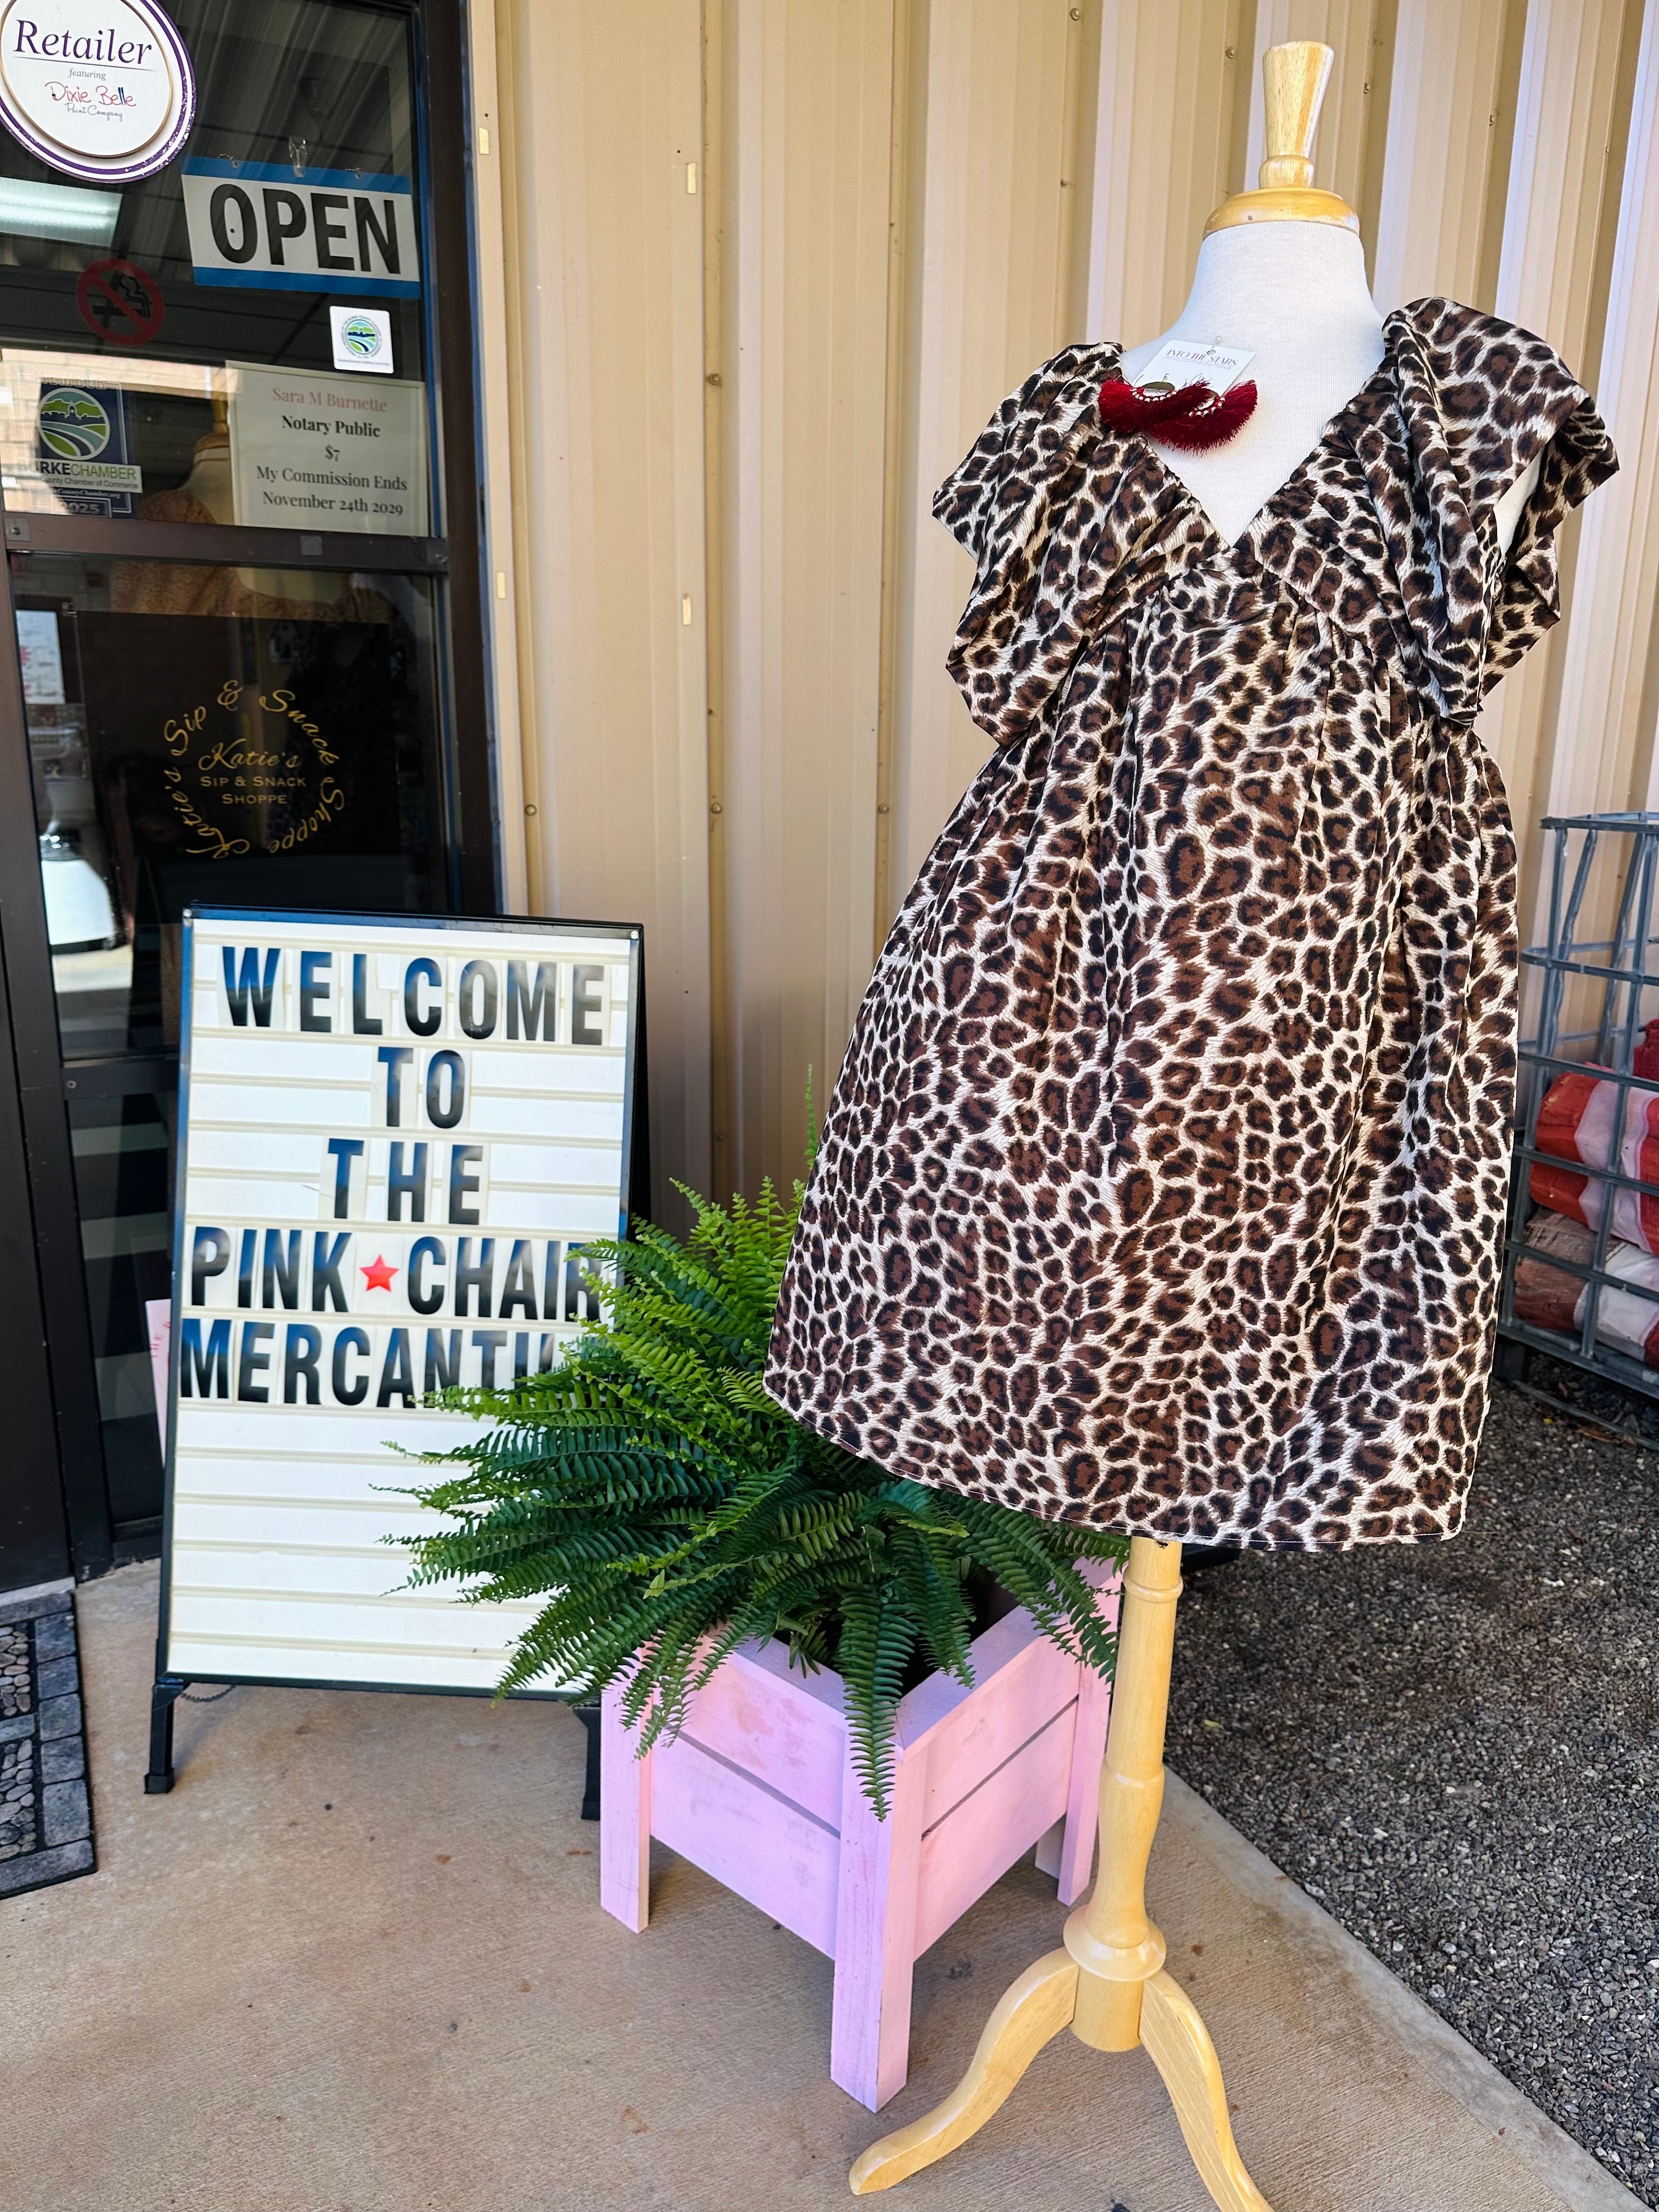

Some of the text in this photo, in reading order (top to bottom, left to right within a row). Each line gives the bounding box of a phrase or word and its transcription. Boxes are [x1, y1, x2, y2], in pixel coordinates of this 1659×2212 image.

[13, 19, 152, 64] Retailer
[69, 68, 106, 81] featuring
[44, 81, 137, 106] Dixie Belle
[64, 102, 123, 122] Paint Company
[210, 183, 400, 275] OPEN
[1166, 349, 1190, 358] INTO
[1209, 354, 1239, 366] STARS
[1197, 361, 1233, 370] BOUTIQUE
[272, 387, 387, 413] Sara M Burnette
[282, 415, 381, 438] Notary Public
[325, 444, 341, 462] $7
[36, 460, 137, 480] RKECHAMBER
[256, 465, 408, 491] My Commission Ends
[263, 492, 403, 517] November 24th 2029
[198, 738, 301, 770] Katie's
[163, 679, 345, 859] Katie's Sip & Snack Shoppe
[234, 776, 246, 787] &
[222, 946, 605, 1046] WELCOME
[377, 1046, 466, 1130] TO
[328, 1138, 484, 1226] THE
[190, 1226, 603, 1324] PINK CHAIR
